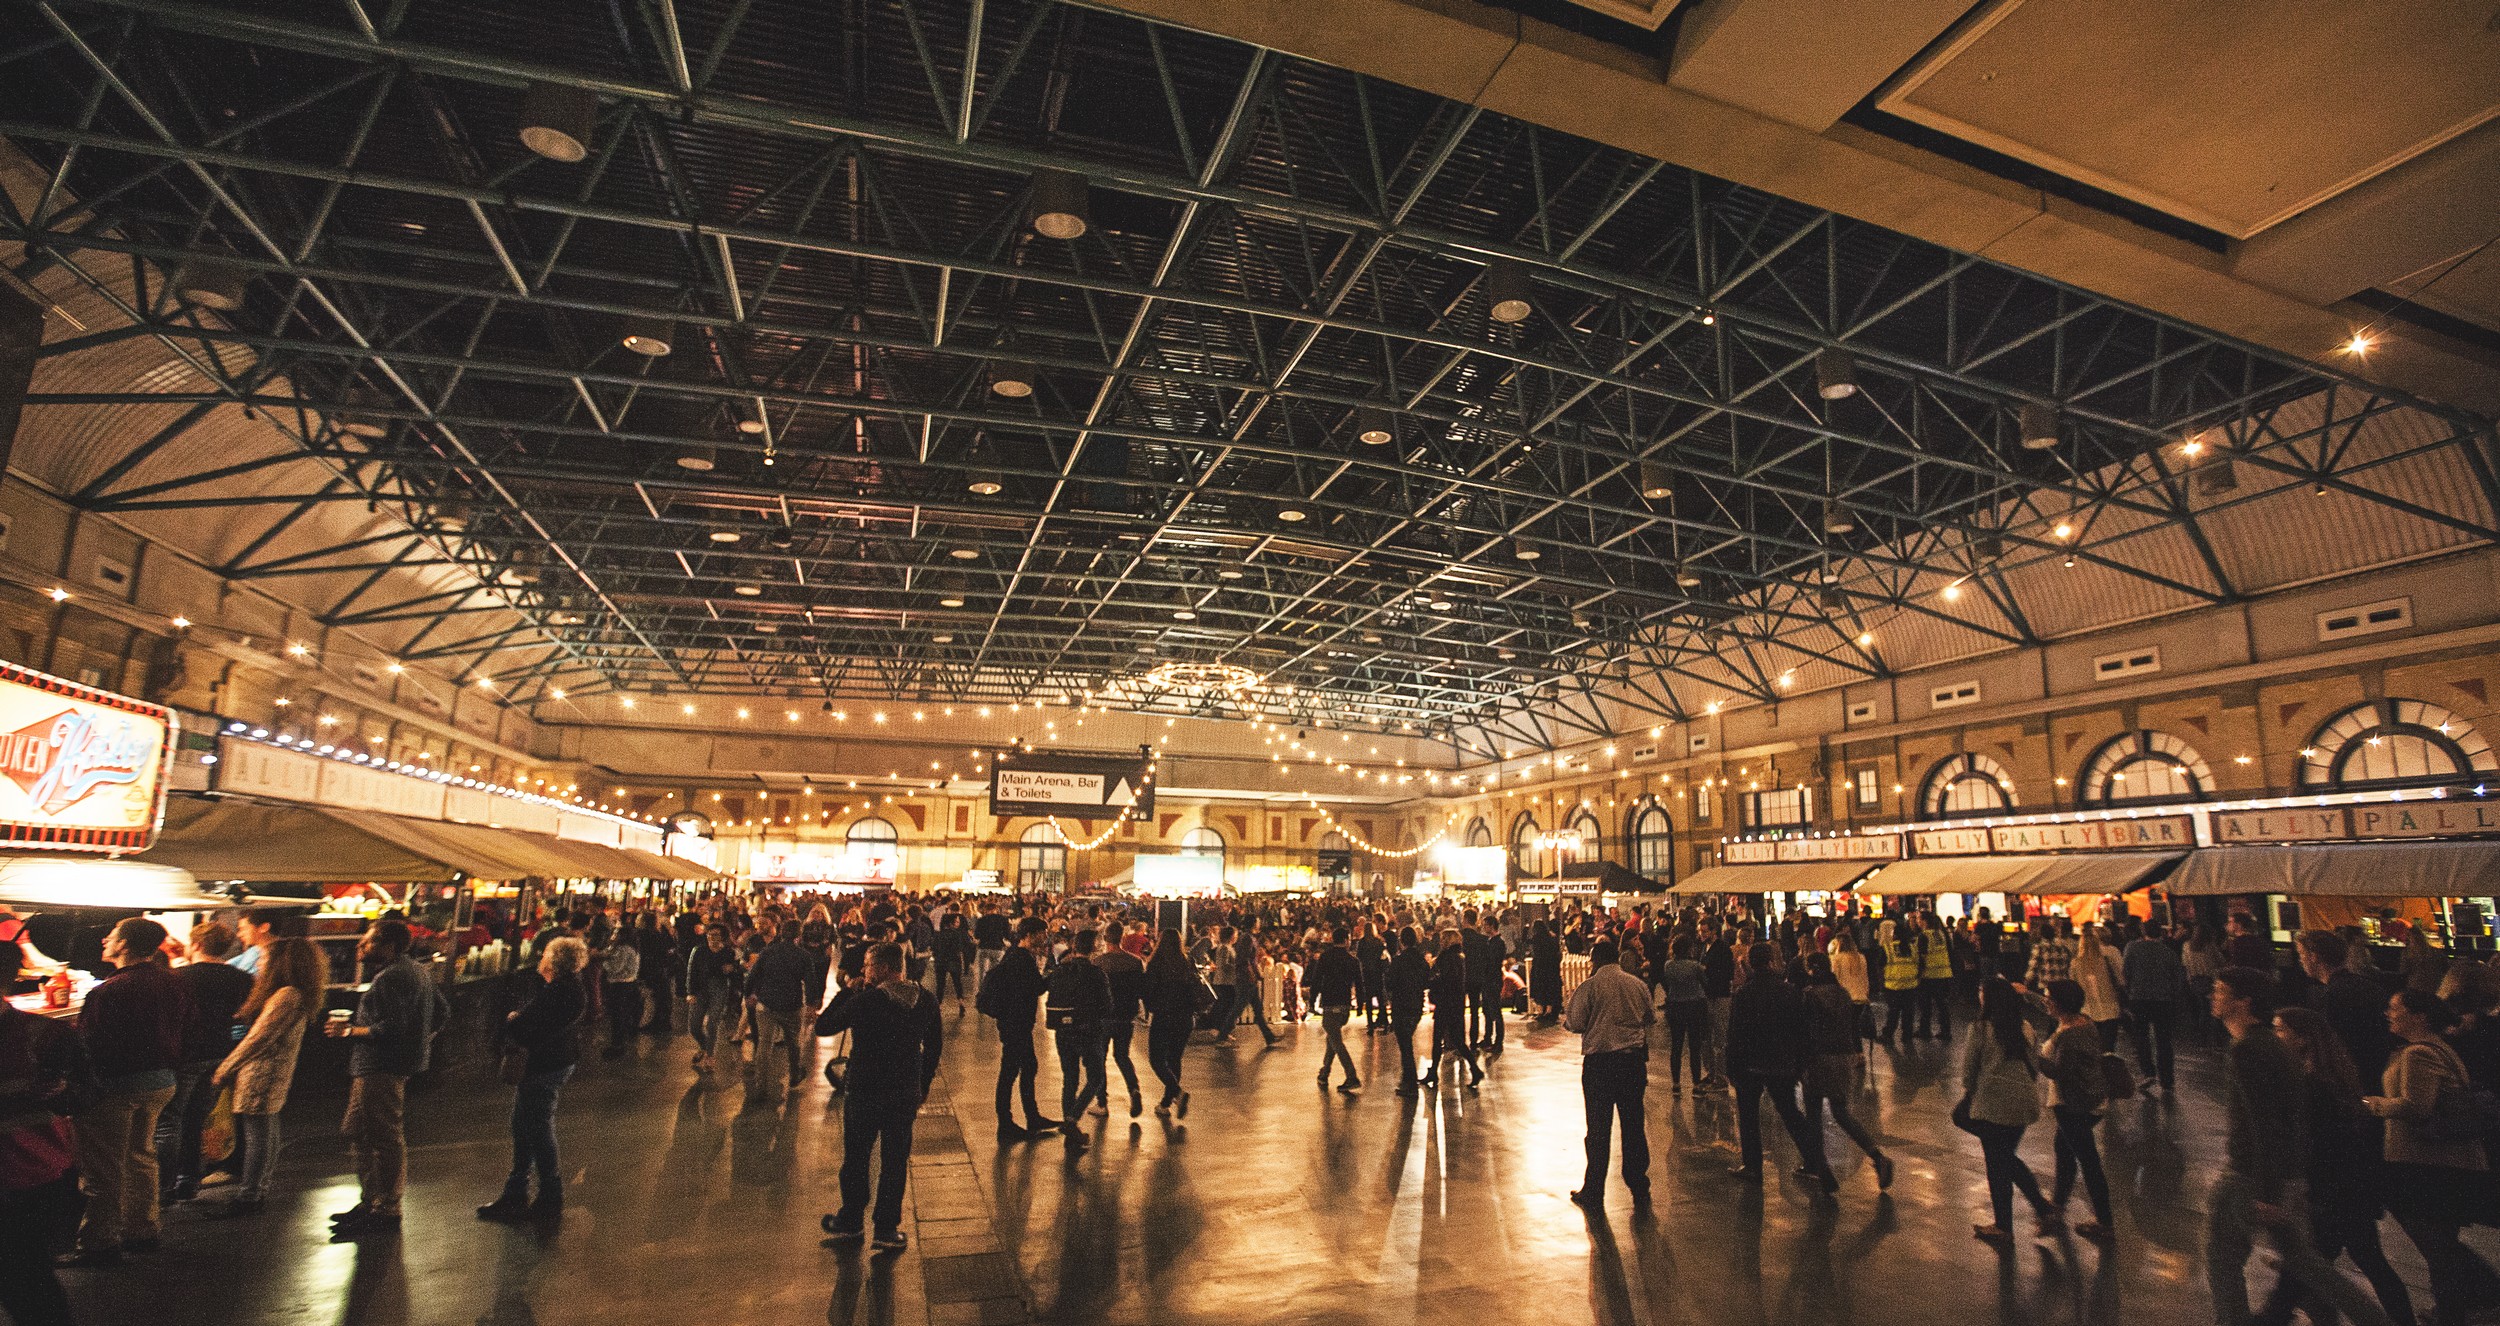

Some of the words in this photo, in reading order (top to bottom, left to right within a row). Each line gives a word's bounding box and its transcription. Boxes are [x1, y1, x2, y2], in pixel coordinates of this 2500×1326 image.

[1001, 773, 1031, 785] Main
[1035, 775, 1074, 788] Arena,
[1078, 777, 1099, 788] Bar
[1001, 786, 1010, 797] &
[1014, 787, 1052, 799] Toilets
[2227, 814, 2336, 836] ALLY
[2363, 807, 2495, 831] PALL
[1919, 833, 1983, 851] ALLY
[1998, 827, 2093, 847] PALLY
[2113, 823, 2175, 842] BAR
[1730, 846, 1771, 860] ALLY
[1781, 842, 1840, 857] PALLY
[1852, 840, 1890, 854] BAR
